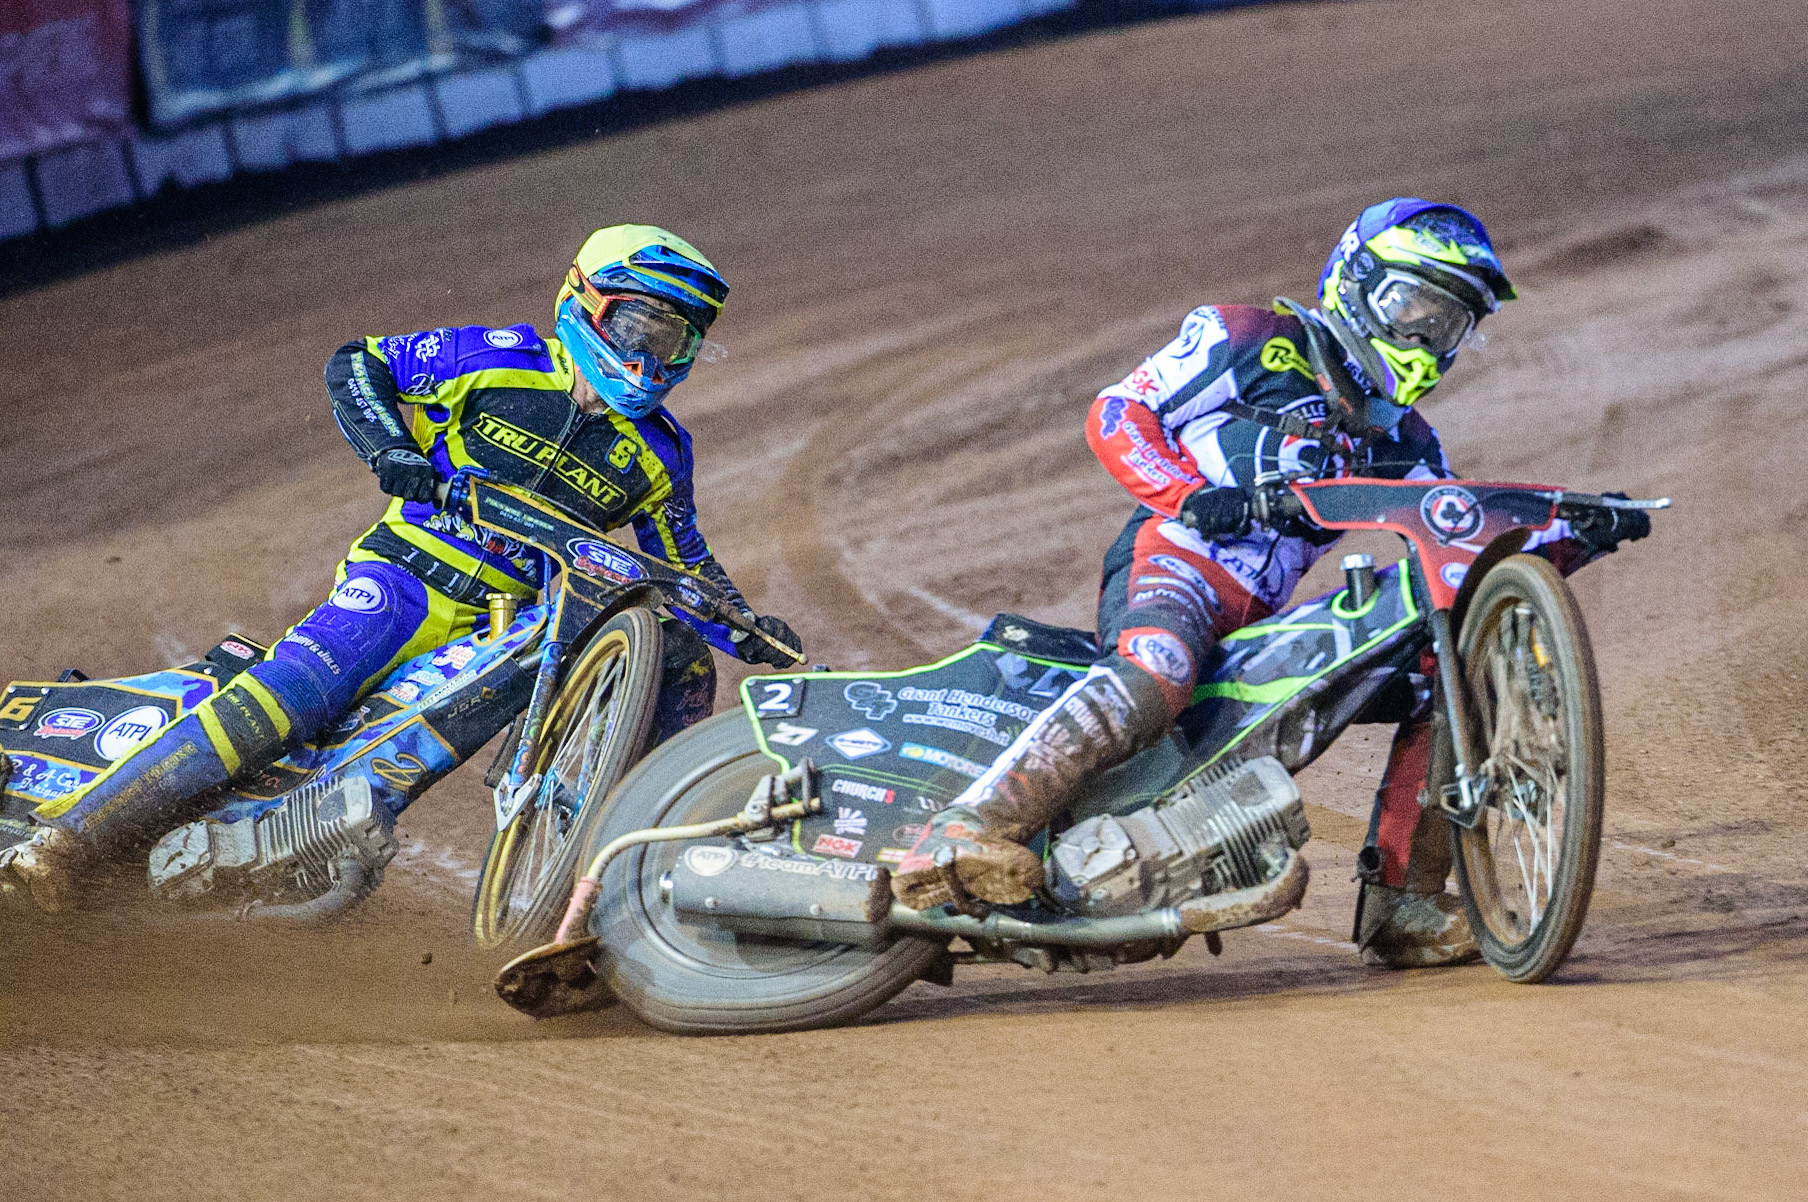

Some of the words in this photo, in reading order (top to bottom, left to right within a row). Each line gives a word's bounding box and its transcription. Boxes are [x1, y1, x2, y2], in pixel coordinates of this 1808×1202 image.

[481, 418, 539, 453] TRU
[535, 446, 621, 505] PLANT
[608, 438, 638, 469] 6
[341, 587, 375, 604] ATPI
[309, 640, 320, 652] &
[317, 649, 342, 676] JULES
[758, 682, 793, 711] 2
[898, 687, 948, 701] Grant
[0, 697, 42, 722] 6
[927, 702, 998, 727] Tankers
[53, 714, 93, 729] STE
[109, 722, 153, 742] ATPI
[23, 764, 37, 776] &
[36, 769, 56, 782] A
[819, 835, 859, 854] NGK
